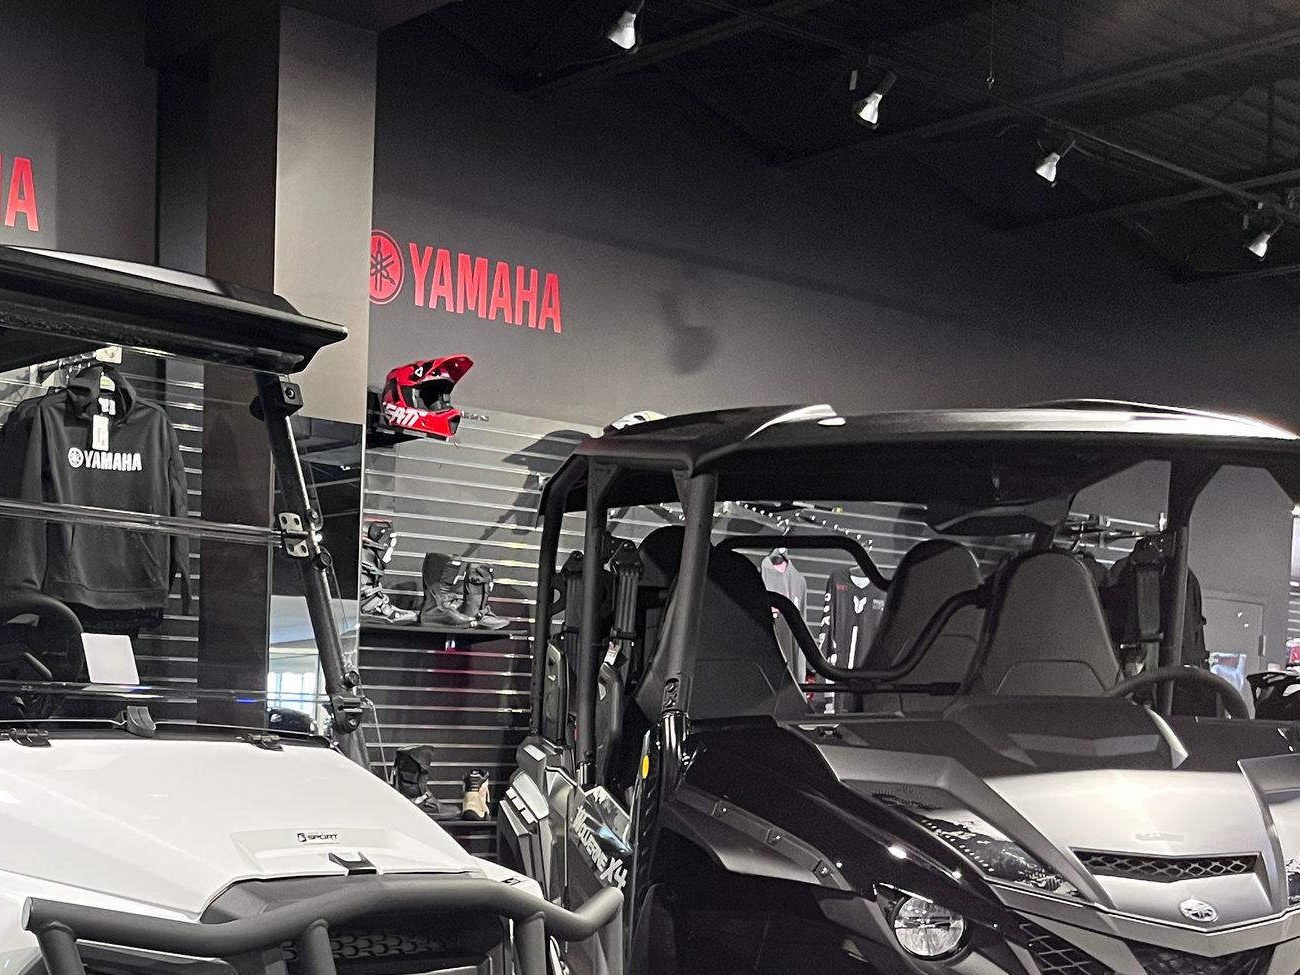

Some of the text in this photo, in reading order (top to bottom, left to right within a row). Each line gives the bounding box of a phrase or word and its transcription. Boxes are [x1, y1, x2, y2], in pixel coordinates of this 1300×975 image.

[408, 242, 562, 334] YAMAHA
[83, 450, 143, 471] YAMAHA
[307, 833, 338, 841] SPORT
[572, 805, 628, 889] WOLVERINE X4
